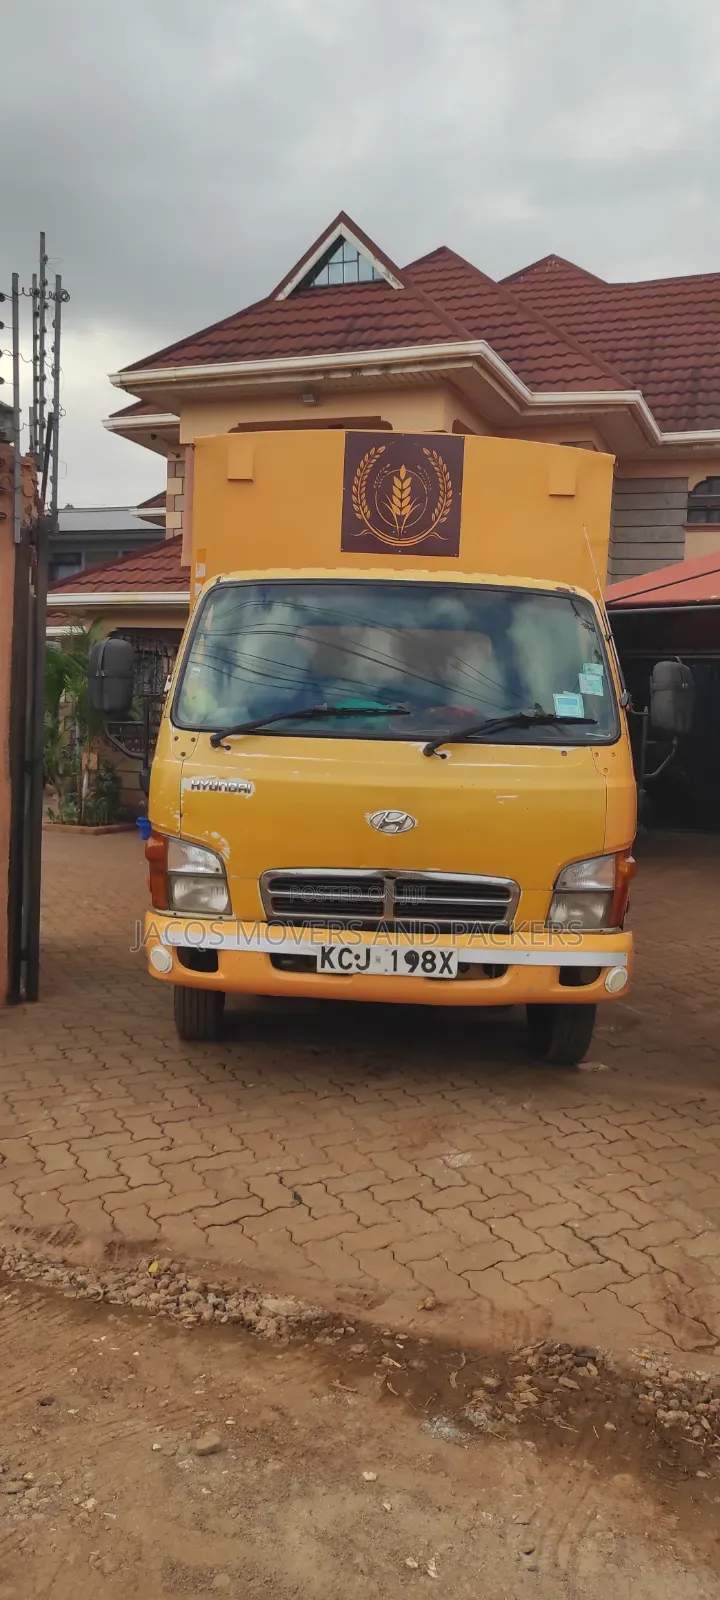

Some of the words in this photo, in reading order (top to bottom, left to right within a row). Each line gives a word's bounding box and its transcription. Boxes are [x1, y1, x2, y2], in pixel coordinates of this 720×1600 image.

[190, 779, 252, 794] HYUNDAI
[319, 945, 371, 970] KCJ
[390, 949, 454, 975] 198X
